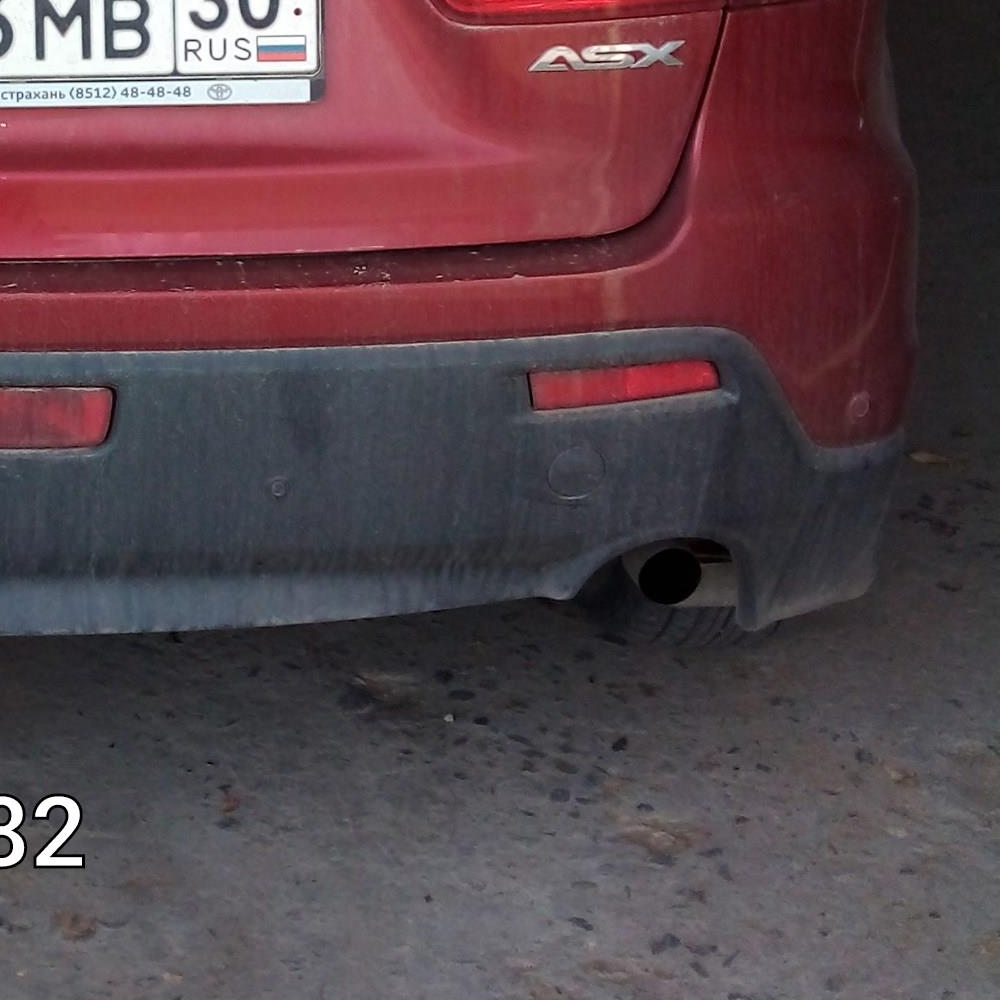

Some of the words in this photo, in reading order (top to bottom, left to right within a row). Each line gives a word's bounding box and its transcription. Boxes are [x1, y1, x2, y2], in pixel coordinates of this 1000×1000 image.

[184, 38, 253, 63] RUS
[527, 40, 686, 72] ASX
[69, 85, 117, 101] (8512)
[120, 85, 192, 99] 48-48-48
